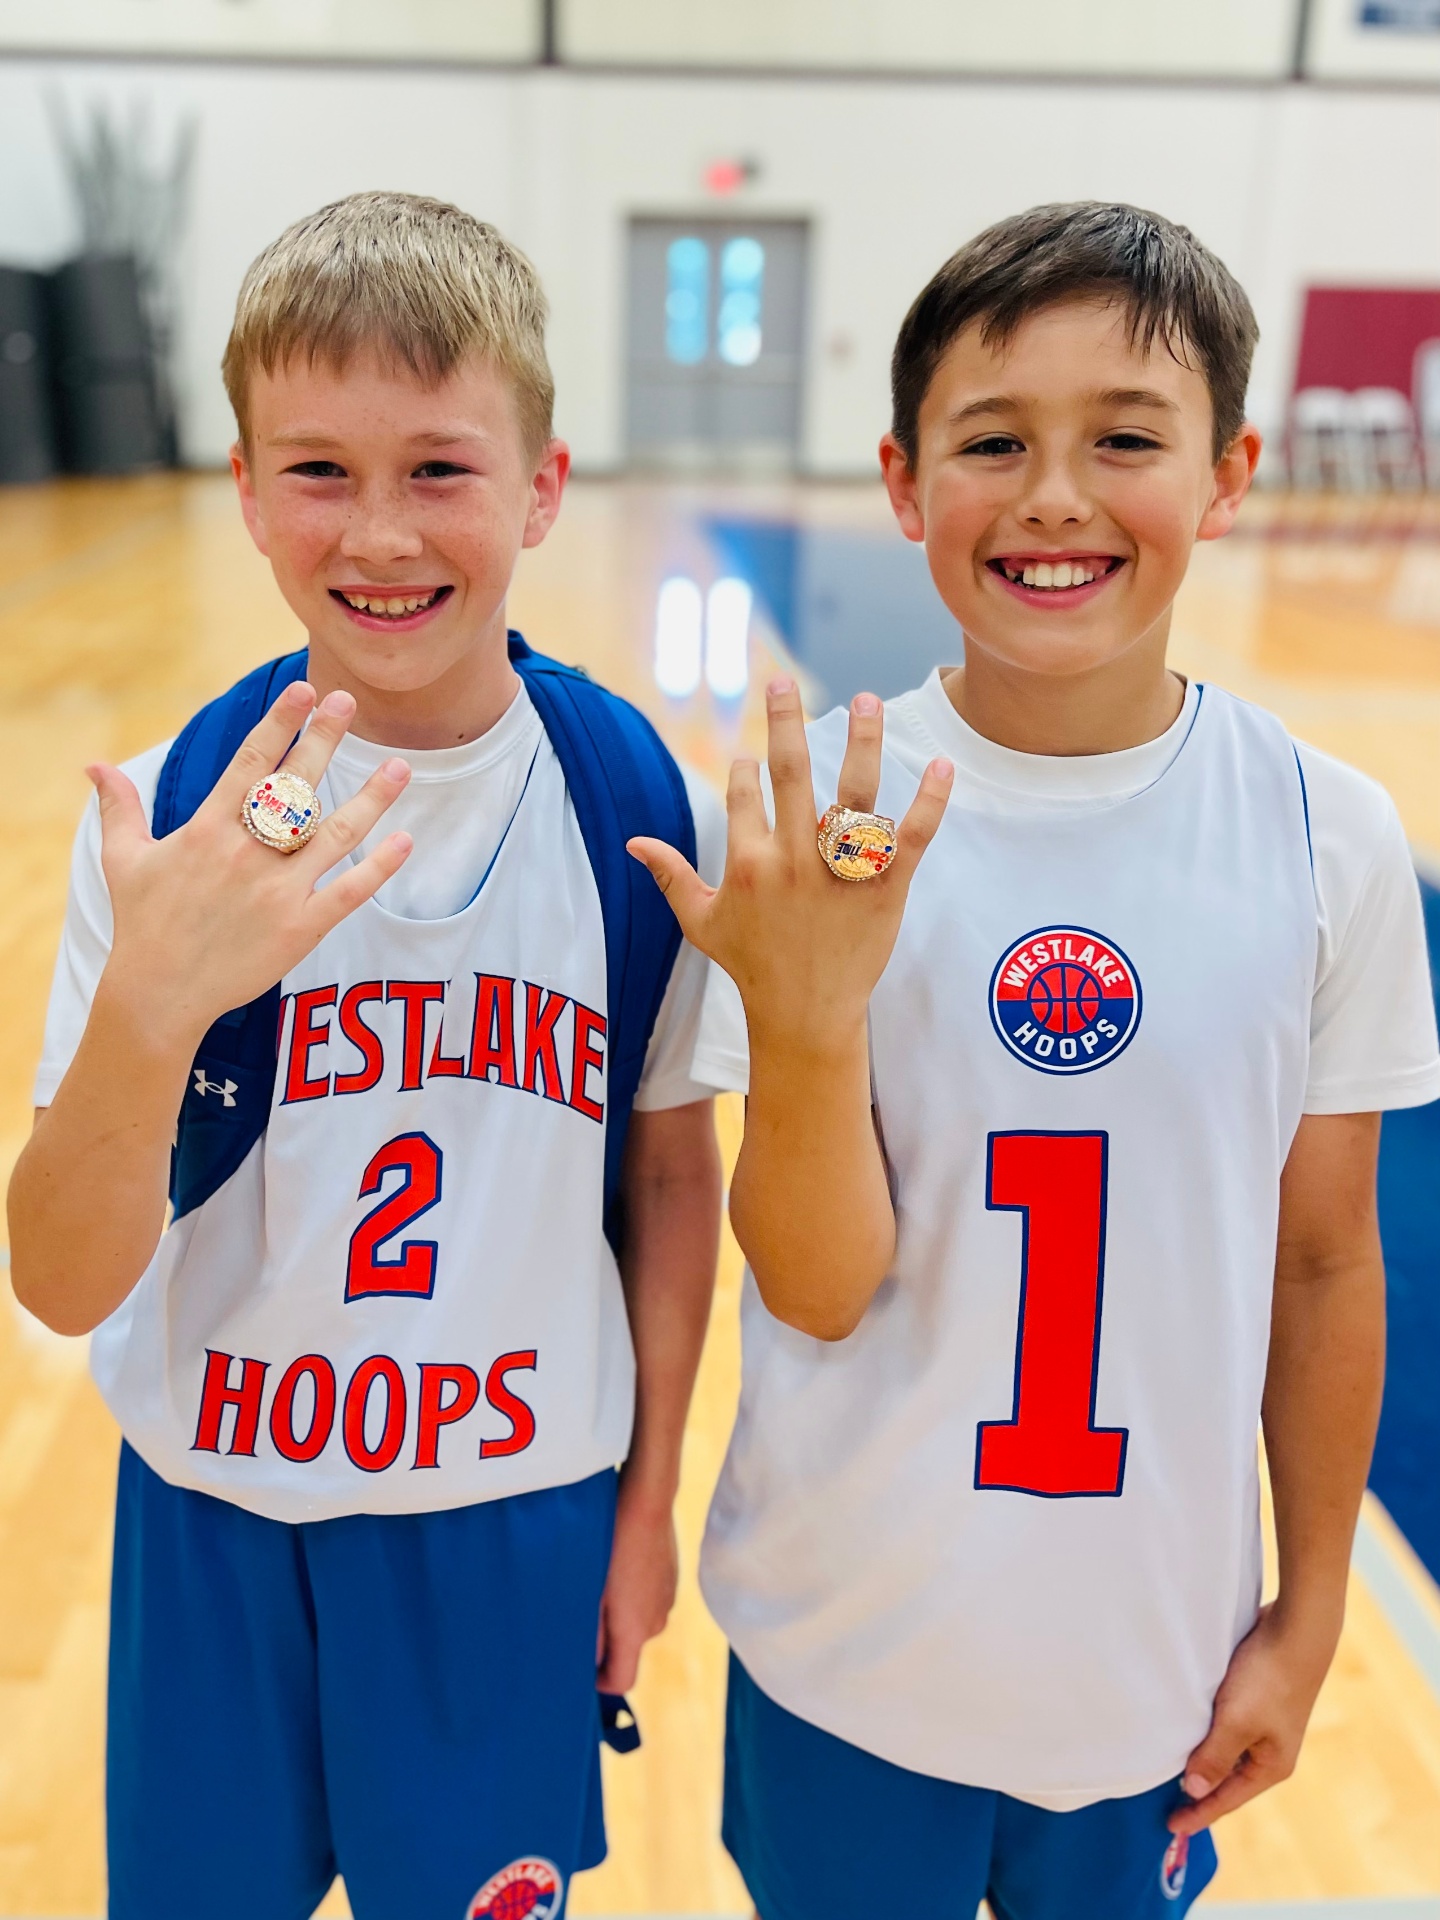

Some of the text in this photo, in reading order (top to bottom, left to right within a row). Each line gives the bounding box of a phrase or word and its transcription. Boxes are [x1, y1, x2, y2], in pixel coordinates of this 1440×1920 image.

[1003, 939, 1124, 988] WESTLAKE
[276, 972, 606, 1125] ESTLAKE
[1013, 1018, 1118, 1060] HOOPS
[343, 1130, 444, 1304] 2
[974, 1129, 1129, 1498] 1
[189, 1348, 538, 1473] HOOPS
